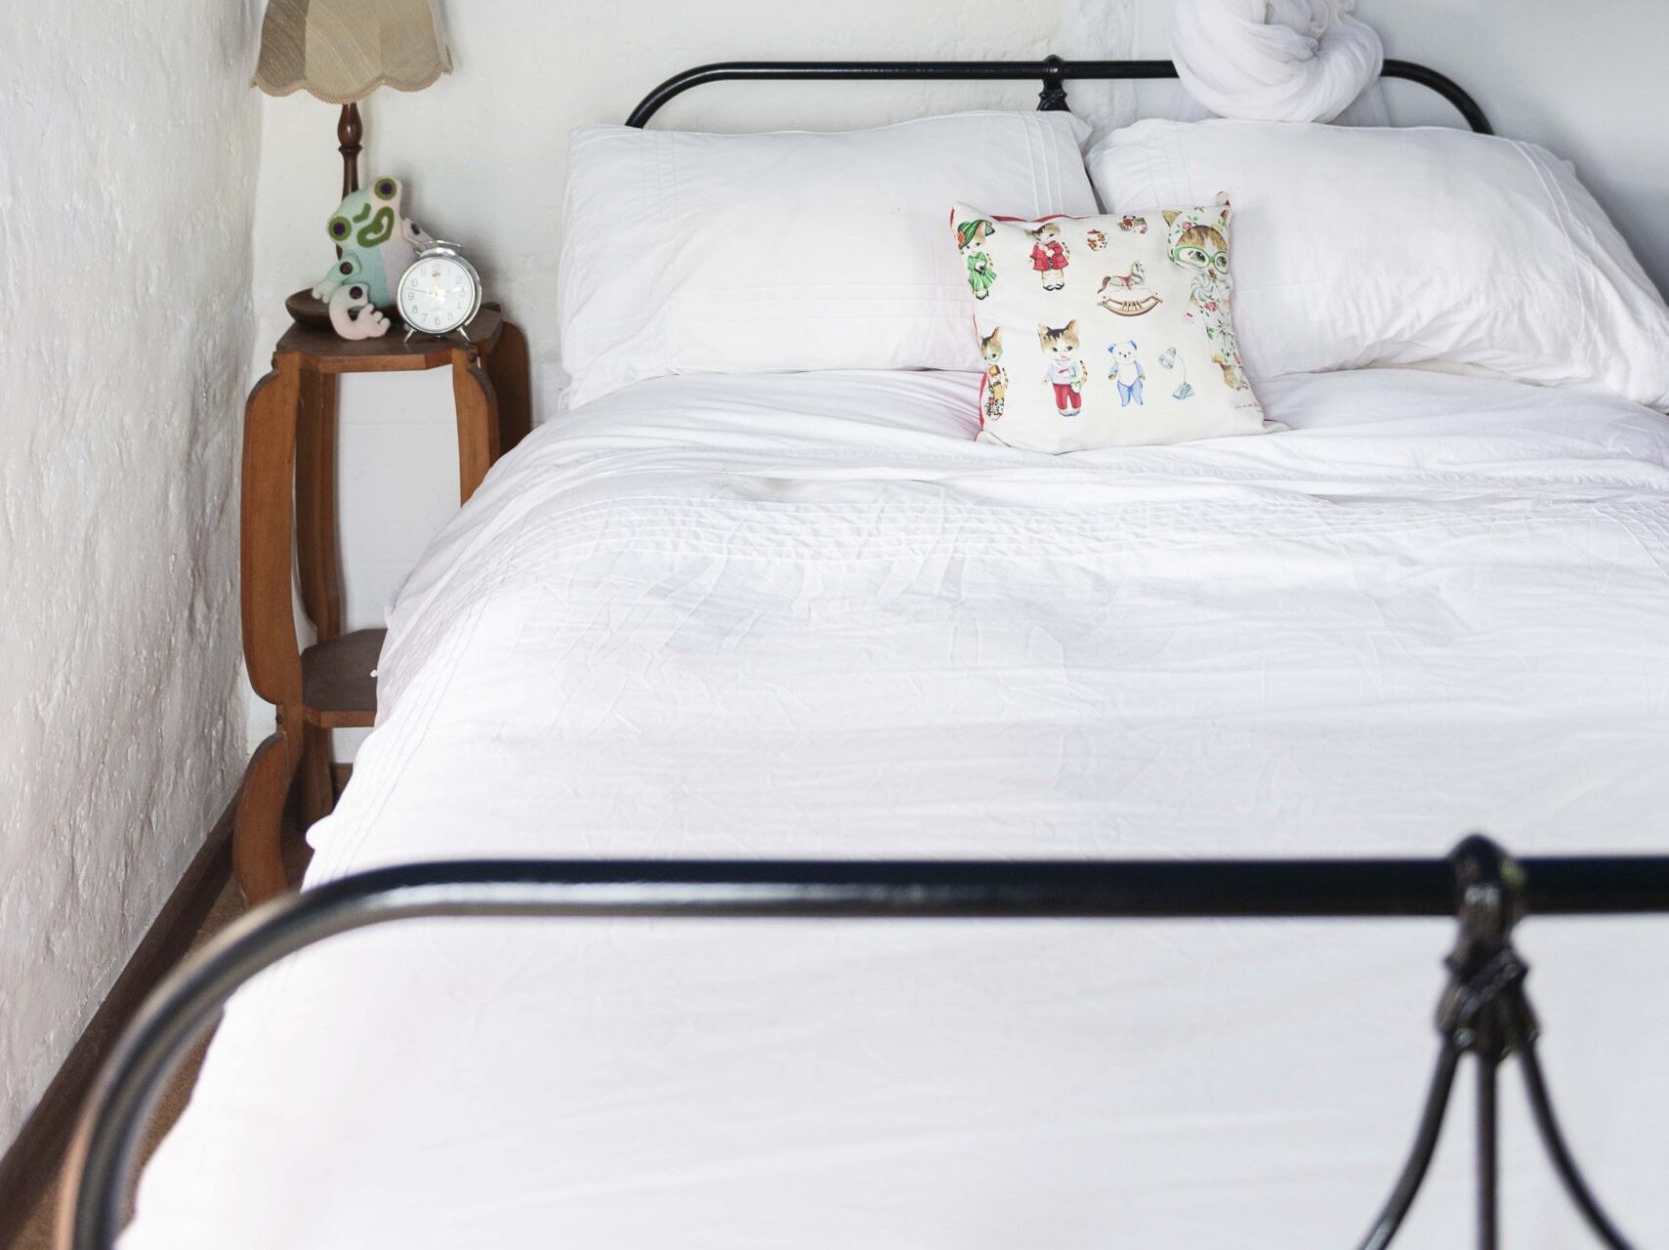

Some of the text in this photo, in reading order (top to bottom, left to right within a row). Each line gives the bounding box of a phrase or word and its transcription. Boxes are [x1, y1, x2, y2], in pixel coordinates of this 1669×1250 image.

[408, 291, 415, 302] 9
[412, 304, 418, 314] 8
[421, 313, 428, 322] 7
[434, 315, 441, 326] 6
